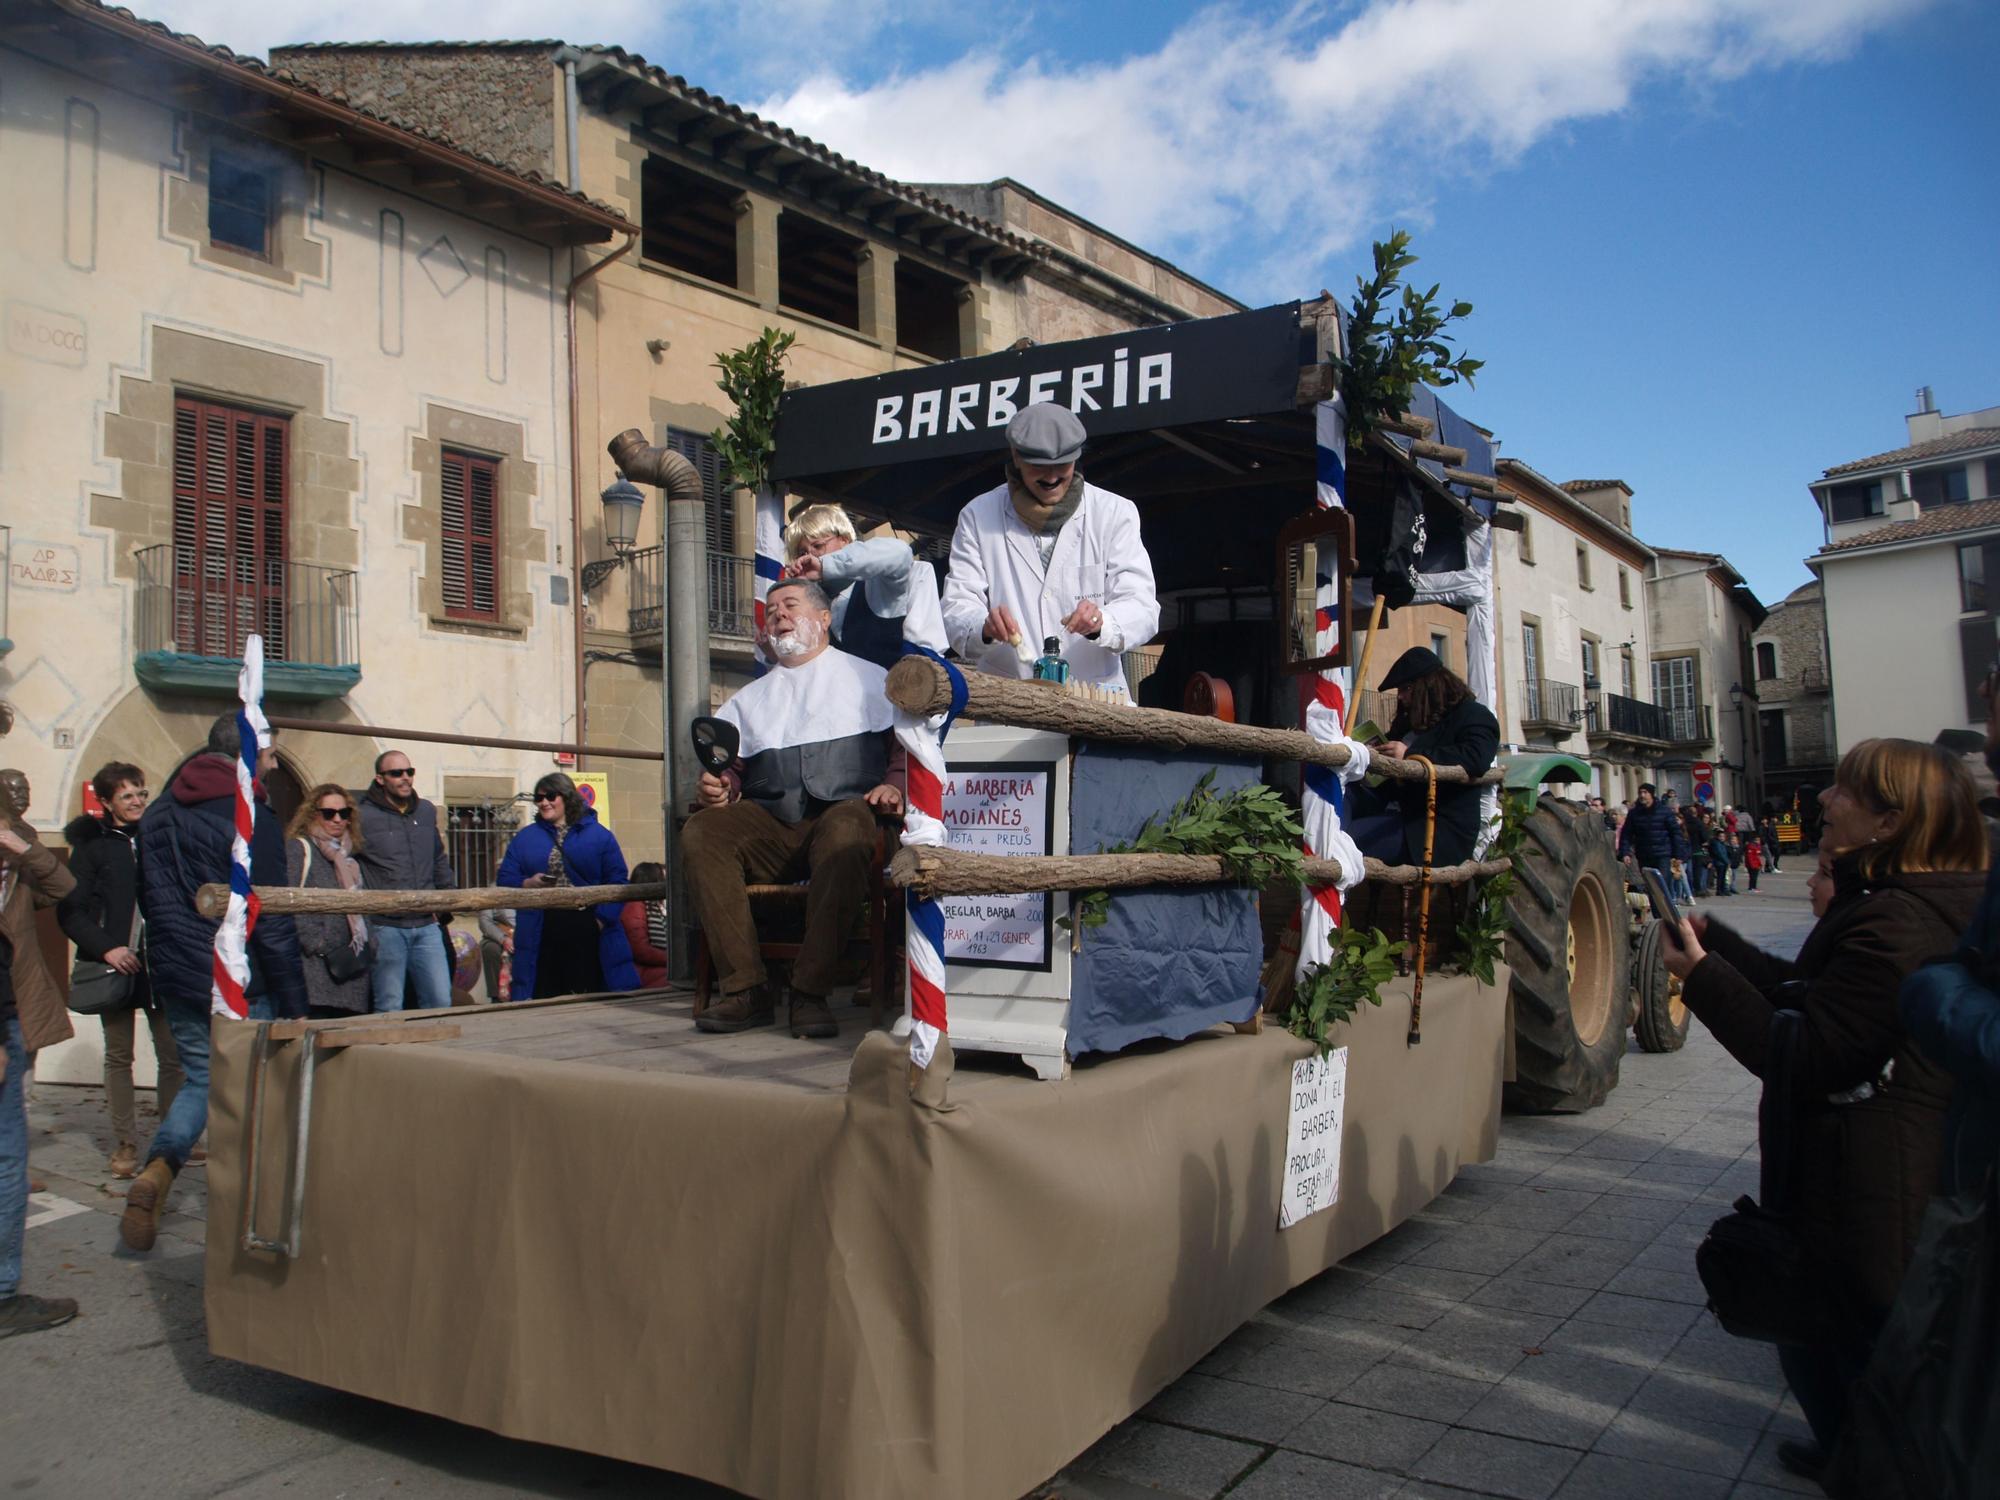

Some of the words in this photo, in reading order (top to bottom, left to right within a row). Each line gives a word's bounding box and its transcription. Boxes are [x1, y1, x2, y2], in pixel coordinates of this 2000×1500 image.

[997, 833, 1032, 846] PREUS
[943, 905, 986, 921] REGLAR
[986, 906, 1016, 920] BARBA
[1001, 931, 1035, 944] GENER
[966, 943, 988, 954] 1963
[1295, 1088, 1318, 1112] DONA
[1290, 1148, 1326, 1175] PROCURA
